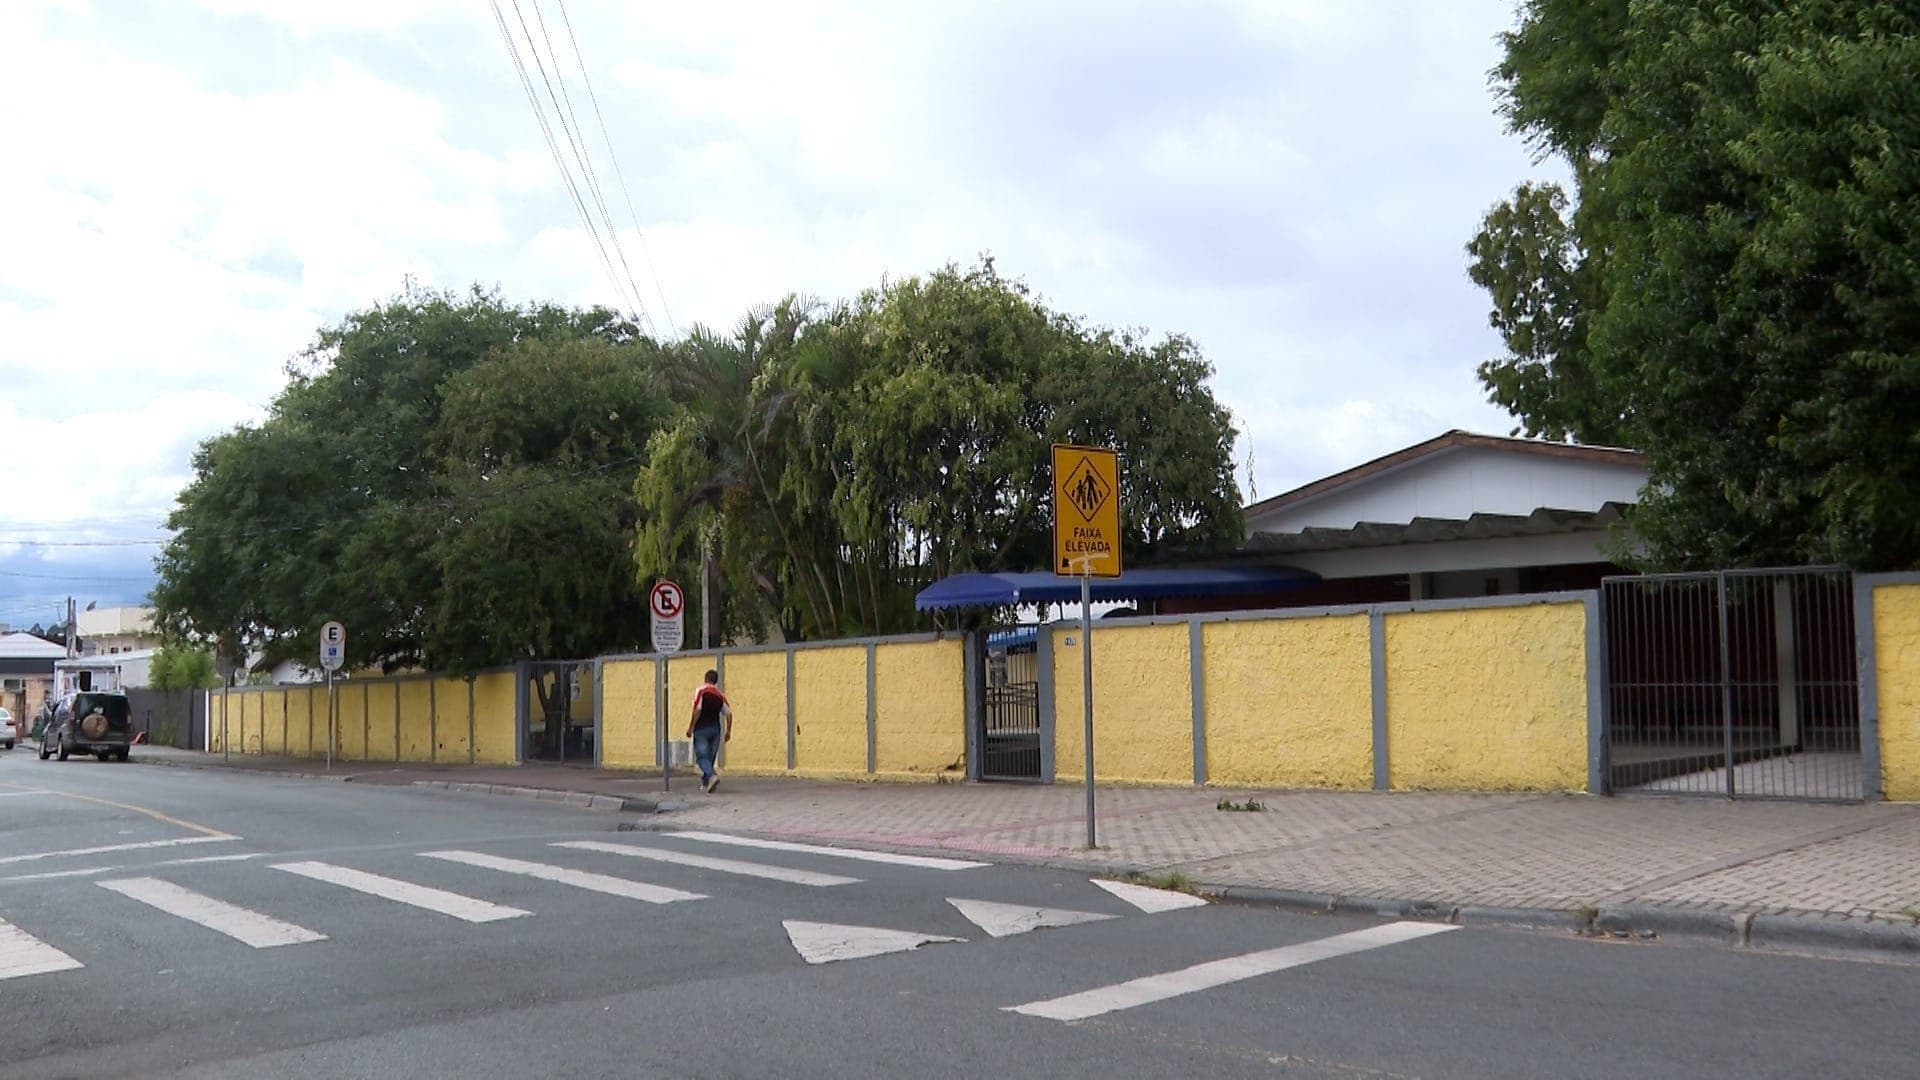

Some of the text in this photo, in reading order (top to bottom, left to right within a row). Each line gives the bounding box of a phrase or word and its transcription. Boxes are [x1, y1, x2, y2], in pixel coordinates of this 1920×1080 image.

[1073, 527, 1102, 538] FAIXA
[1065, 540, 1111, 552] ELEVADA
[328, 627, 338, 640] E
